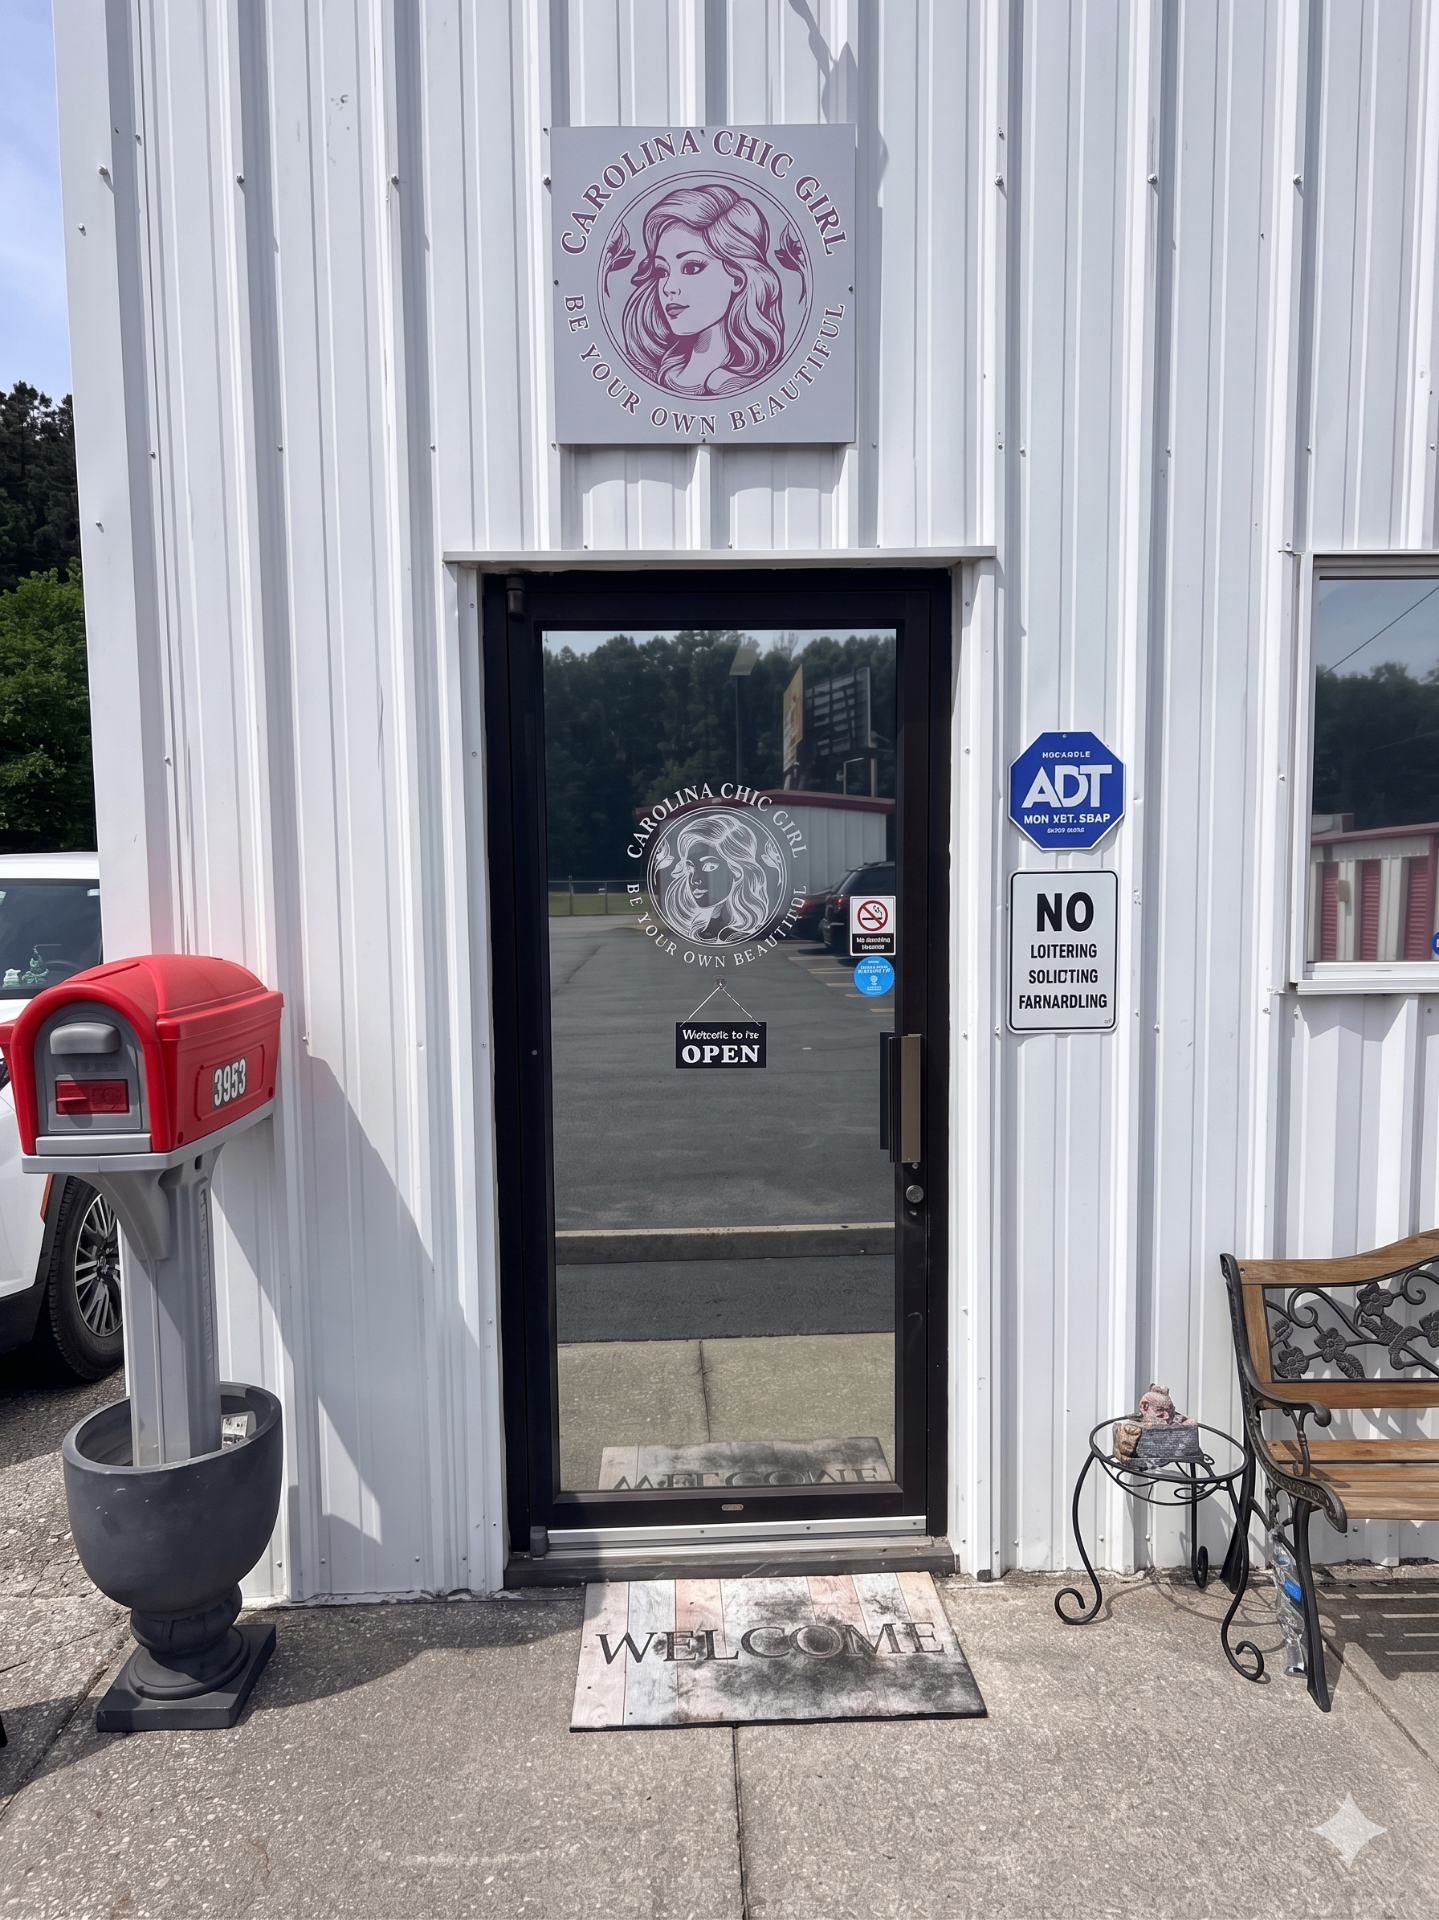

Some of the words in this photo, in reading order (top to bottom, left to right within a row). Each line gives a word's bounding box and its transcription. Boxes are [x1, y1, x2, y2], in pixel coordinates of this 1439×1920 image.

[561, 129, 701, 255] CAROLINA
[712, 129, 794, 179] CHIC
[794, 175, 847, 256] GIRL
[564, 294, 590, 332] BE
[579, 343, 642, 414] YOUR
[650, 407, 716, 435] OWN
[728, 303, 845, 431] BEAUTIFUL
[1021, 764, 1113, 808] ADT
[627, 782, 715, 859] CAROLINA
[720, 782, 773, 812] CHIC
[772, 810, 807, 859] GIRL
[1024, 814, 1049, 825] MON
[627, 883, 643, 907] BE
[637, 911, 677, 956] YOUR
[683, 951, 725, 968] OWN
[1036, 891, 1094, 932] NO
[1030, 943, 1098, 959] LOITERING
[1018, 993, 1108, 1009] FARNARDLING
[681, 1044, 760, 1064] OPEN
[213, 1057, 247, 1107] 3953
[595, 1621, 945, 1666] WELCOME
